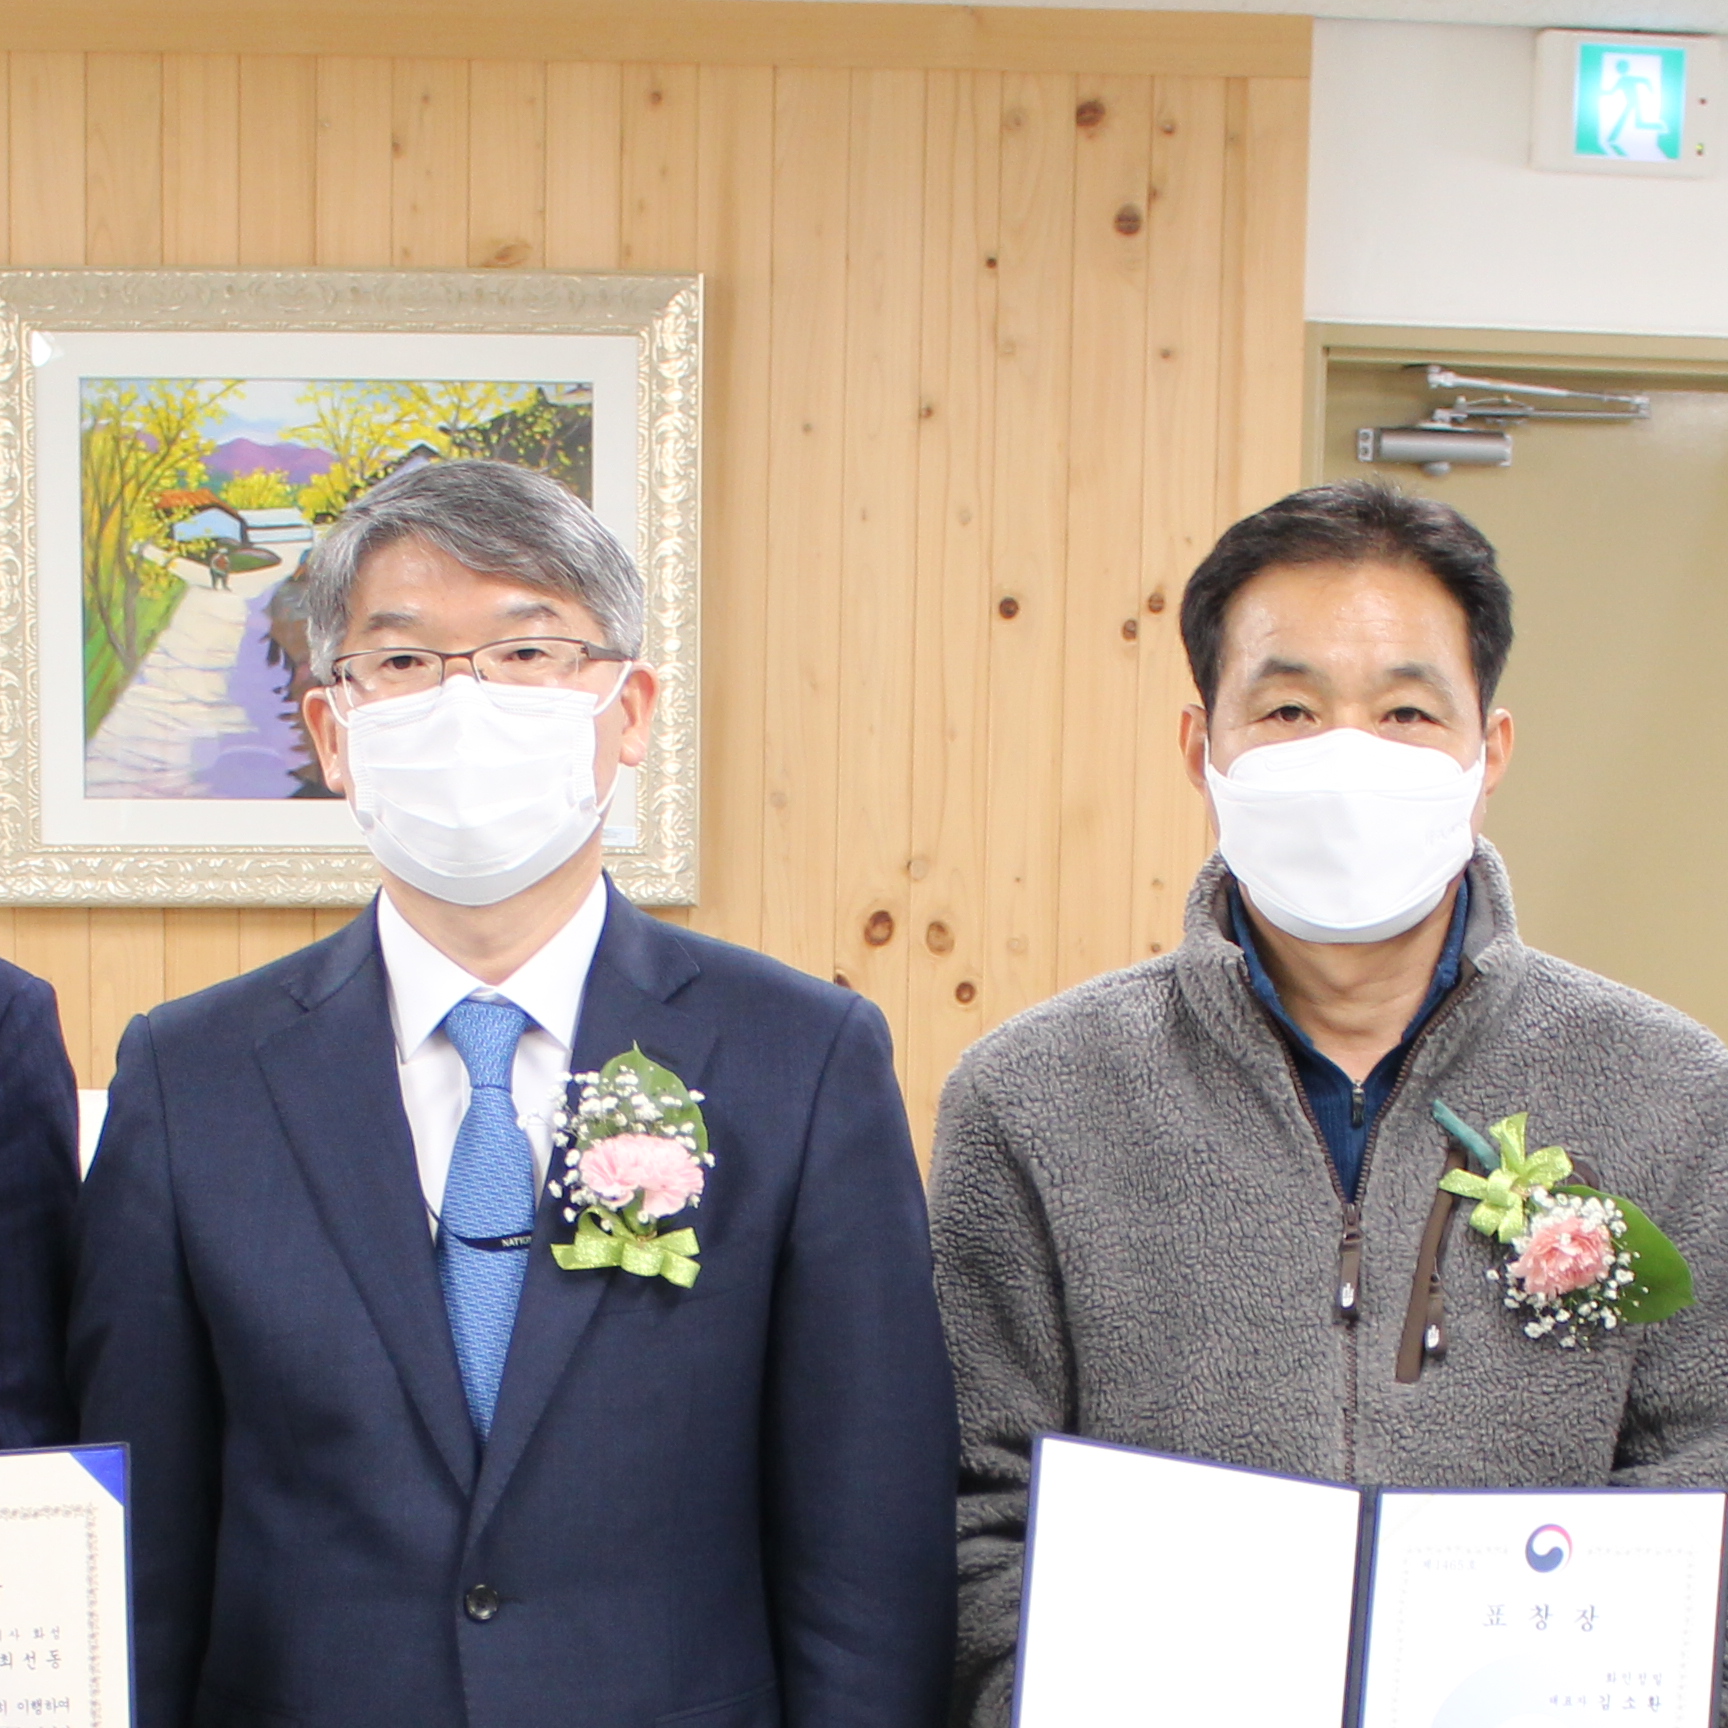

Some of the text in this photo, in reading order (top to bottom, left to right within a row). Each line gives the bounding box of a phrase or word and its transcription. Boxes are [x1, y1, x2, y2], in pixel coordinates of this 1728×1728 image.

[1483, 1603, 1599, 1633] 표창장
[16, 1696, 70, 1716] 이행하여
[1549, 1694, 1587, 1707] 대표자
